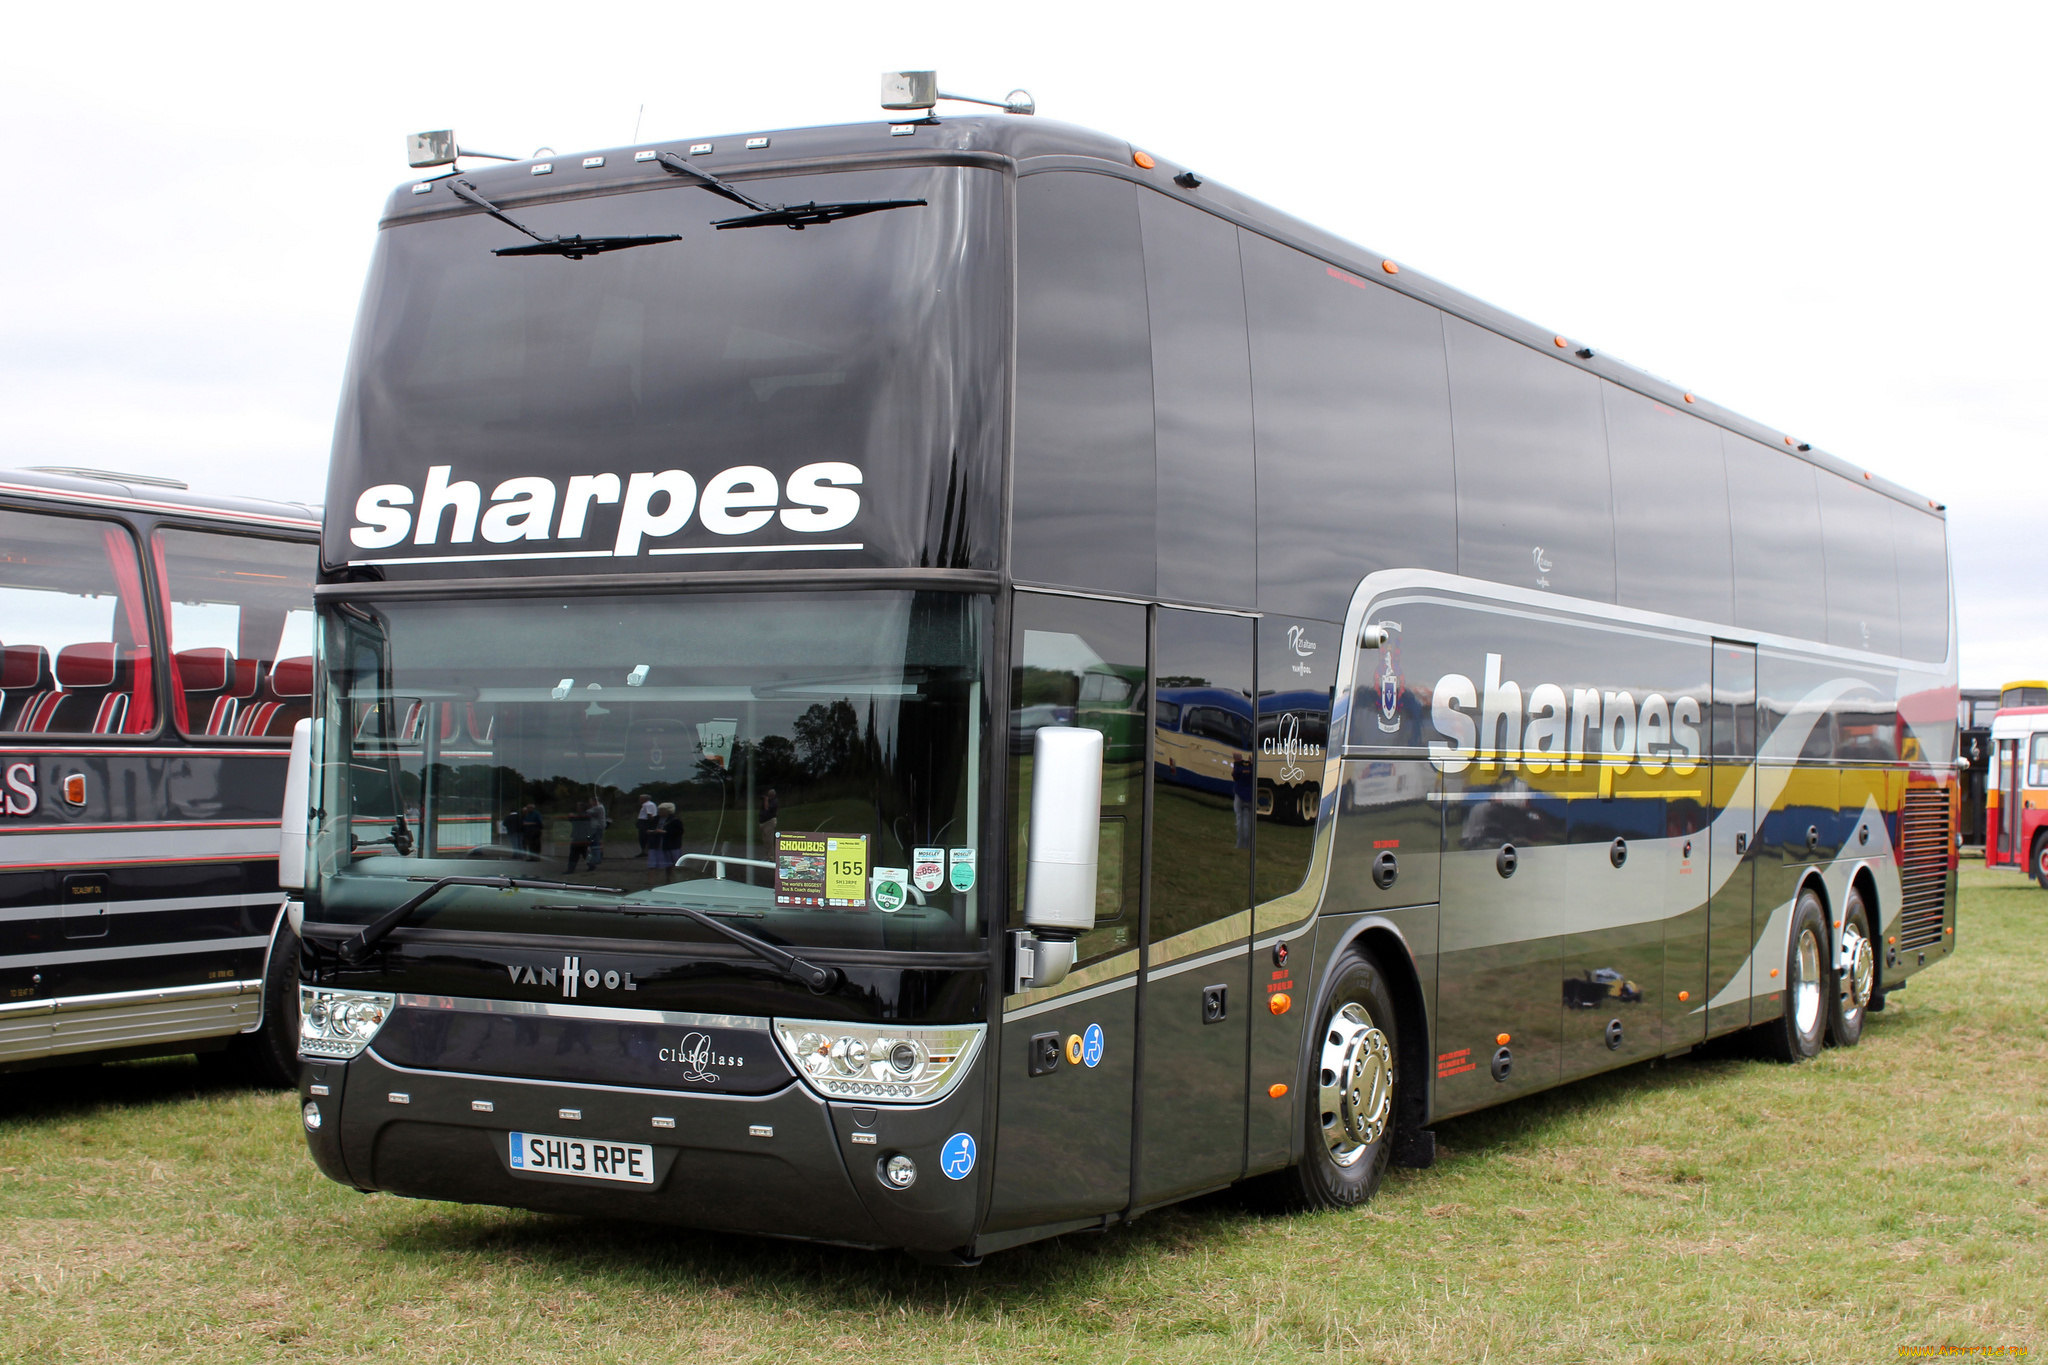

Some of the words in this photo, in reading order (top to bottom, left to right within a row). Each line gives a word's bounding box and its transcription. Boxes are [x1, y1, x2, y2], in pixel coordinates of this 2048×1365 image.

[349, 461, 863, 557] sharpes
[1428, 653, 1701, 799] sharpes
[0, 762, 38, 816] S
[779, 840, 826, 852] SHOWBUS
[832, 861, 863, 876] 155
[512, 1156, 523, 1164] GB
[530, 1138, 586, 1171] SH13
[593, 1144, 644, 1178] RPE
